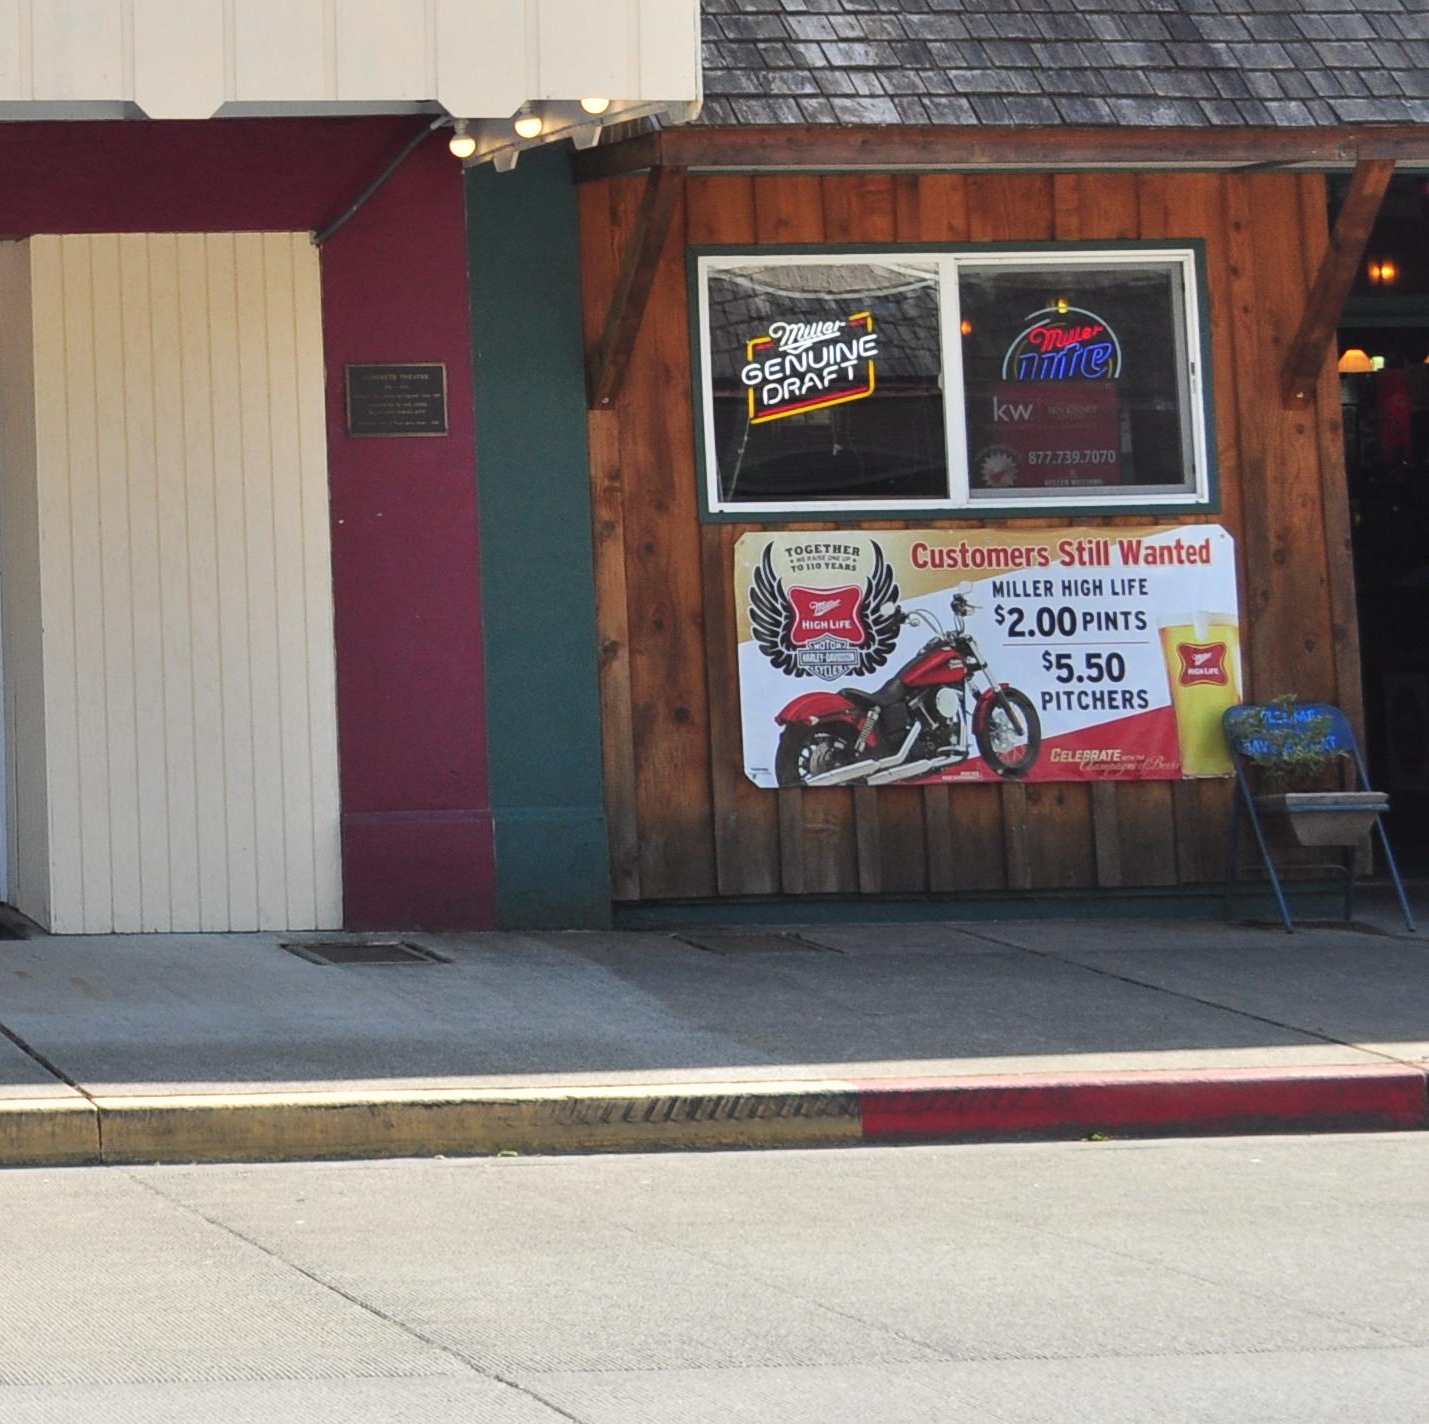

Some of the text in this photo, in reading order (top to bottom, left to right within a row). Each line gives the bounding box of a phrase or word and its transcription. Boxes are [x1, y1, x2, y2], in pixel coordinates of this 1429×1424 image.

[768, 321, 846, 354] Miller
[1029, 326, 1104, 352] Miller
[741, 334, 878, 385] GENUINE
[762, 359, 858, 406] DRAFT
[993, 395, 1033, 422] kw
[1028, 450, 1116, 465] 877.739.7070
[785, 544, 860, 557] TOGETHER
[911, 538, 1212, 570] Customers Still Wanted
[791, 565, 804, 573] TO
[824, 563, 857, 572] YEARS
[992, 578, 1149, 599] MILLER HIGH LIFE
[802, 620, 852, 630] HIGH LIFE
[995, 605, 1147, 639] $2.00 PINTS
[1042, 650, 1126, 684] $5.50
[1041, 689, 1150, 712] PITCHERS
